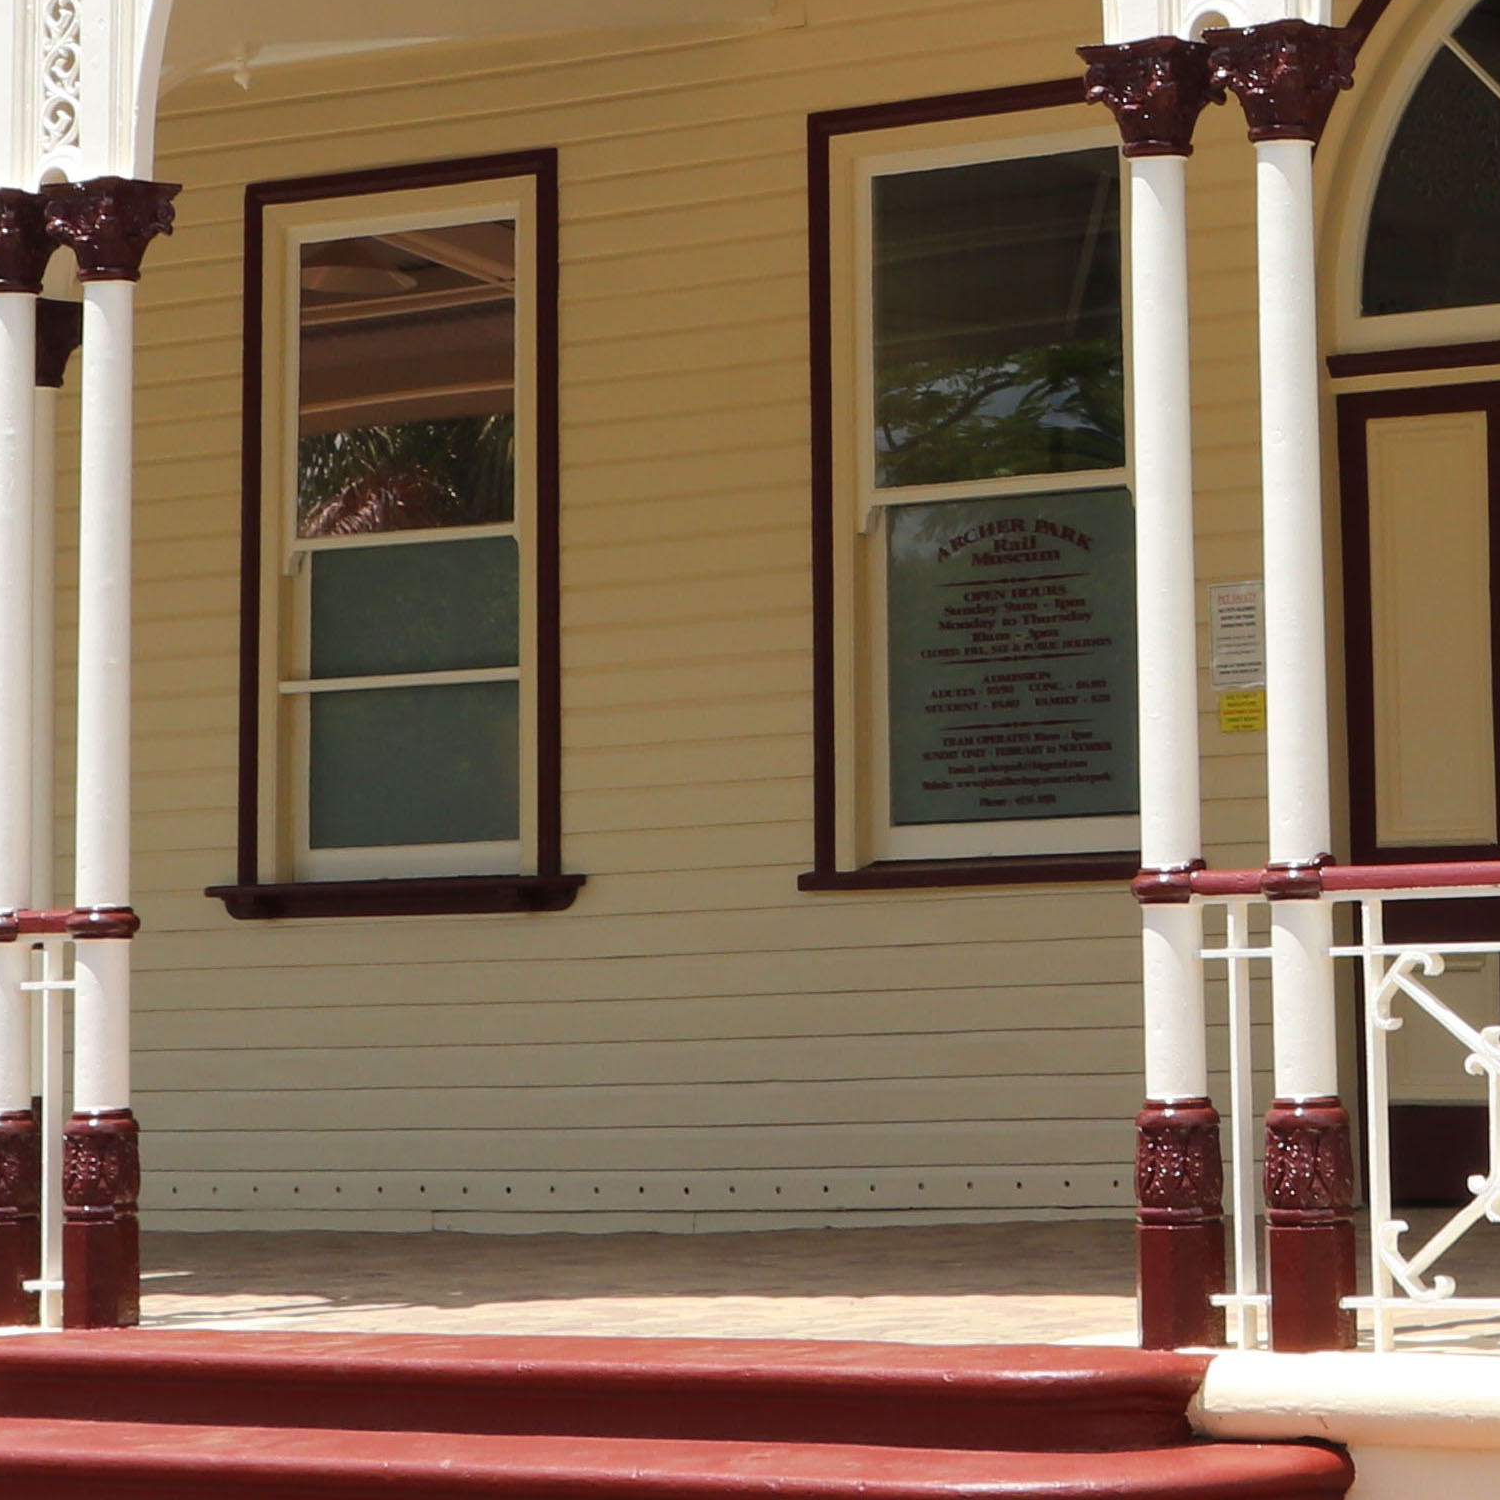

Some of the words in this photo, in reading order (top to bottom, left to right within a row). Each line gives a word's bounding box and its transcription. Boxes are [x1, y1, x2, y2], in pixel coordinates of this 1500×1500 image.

[937, 517, 1026, 563] ARCHER
[1035, 519, 1093, 553] PARK
[994, 535, 1036, 552] Rail
[971, 549, 1060, 566] Museum
